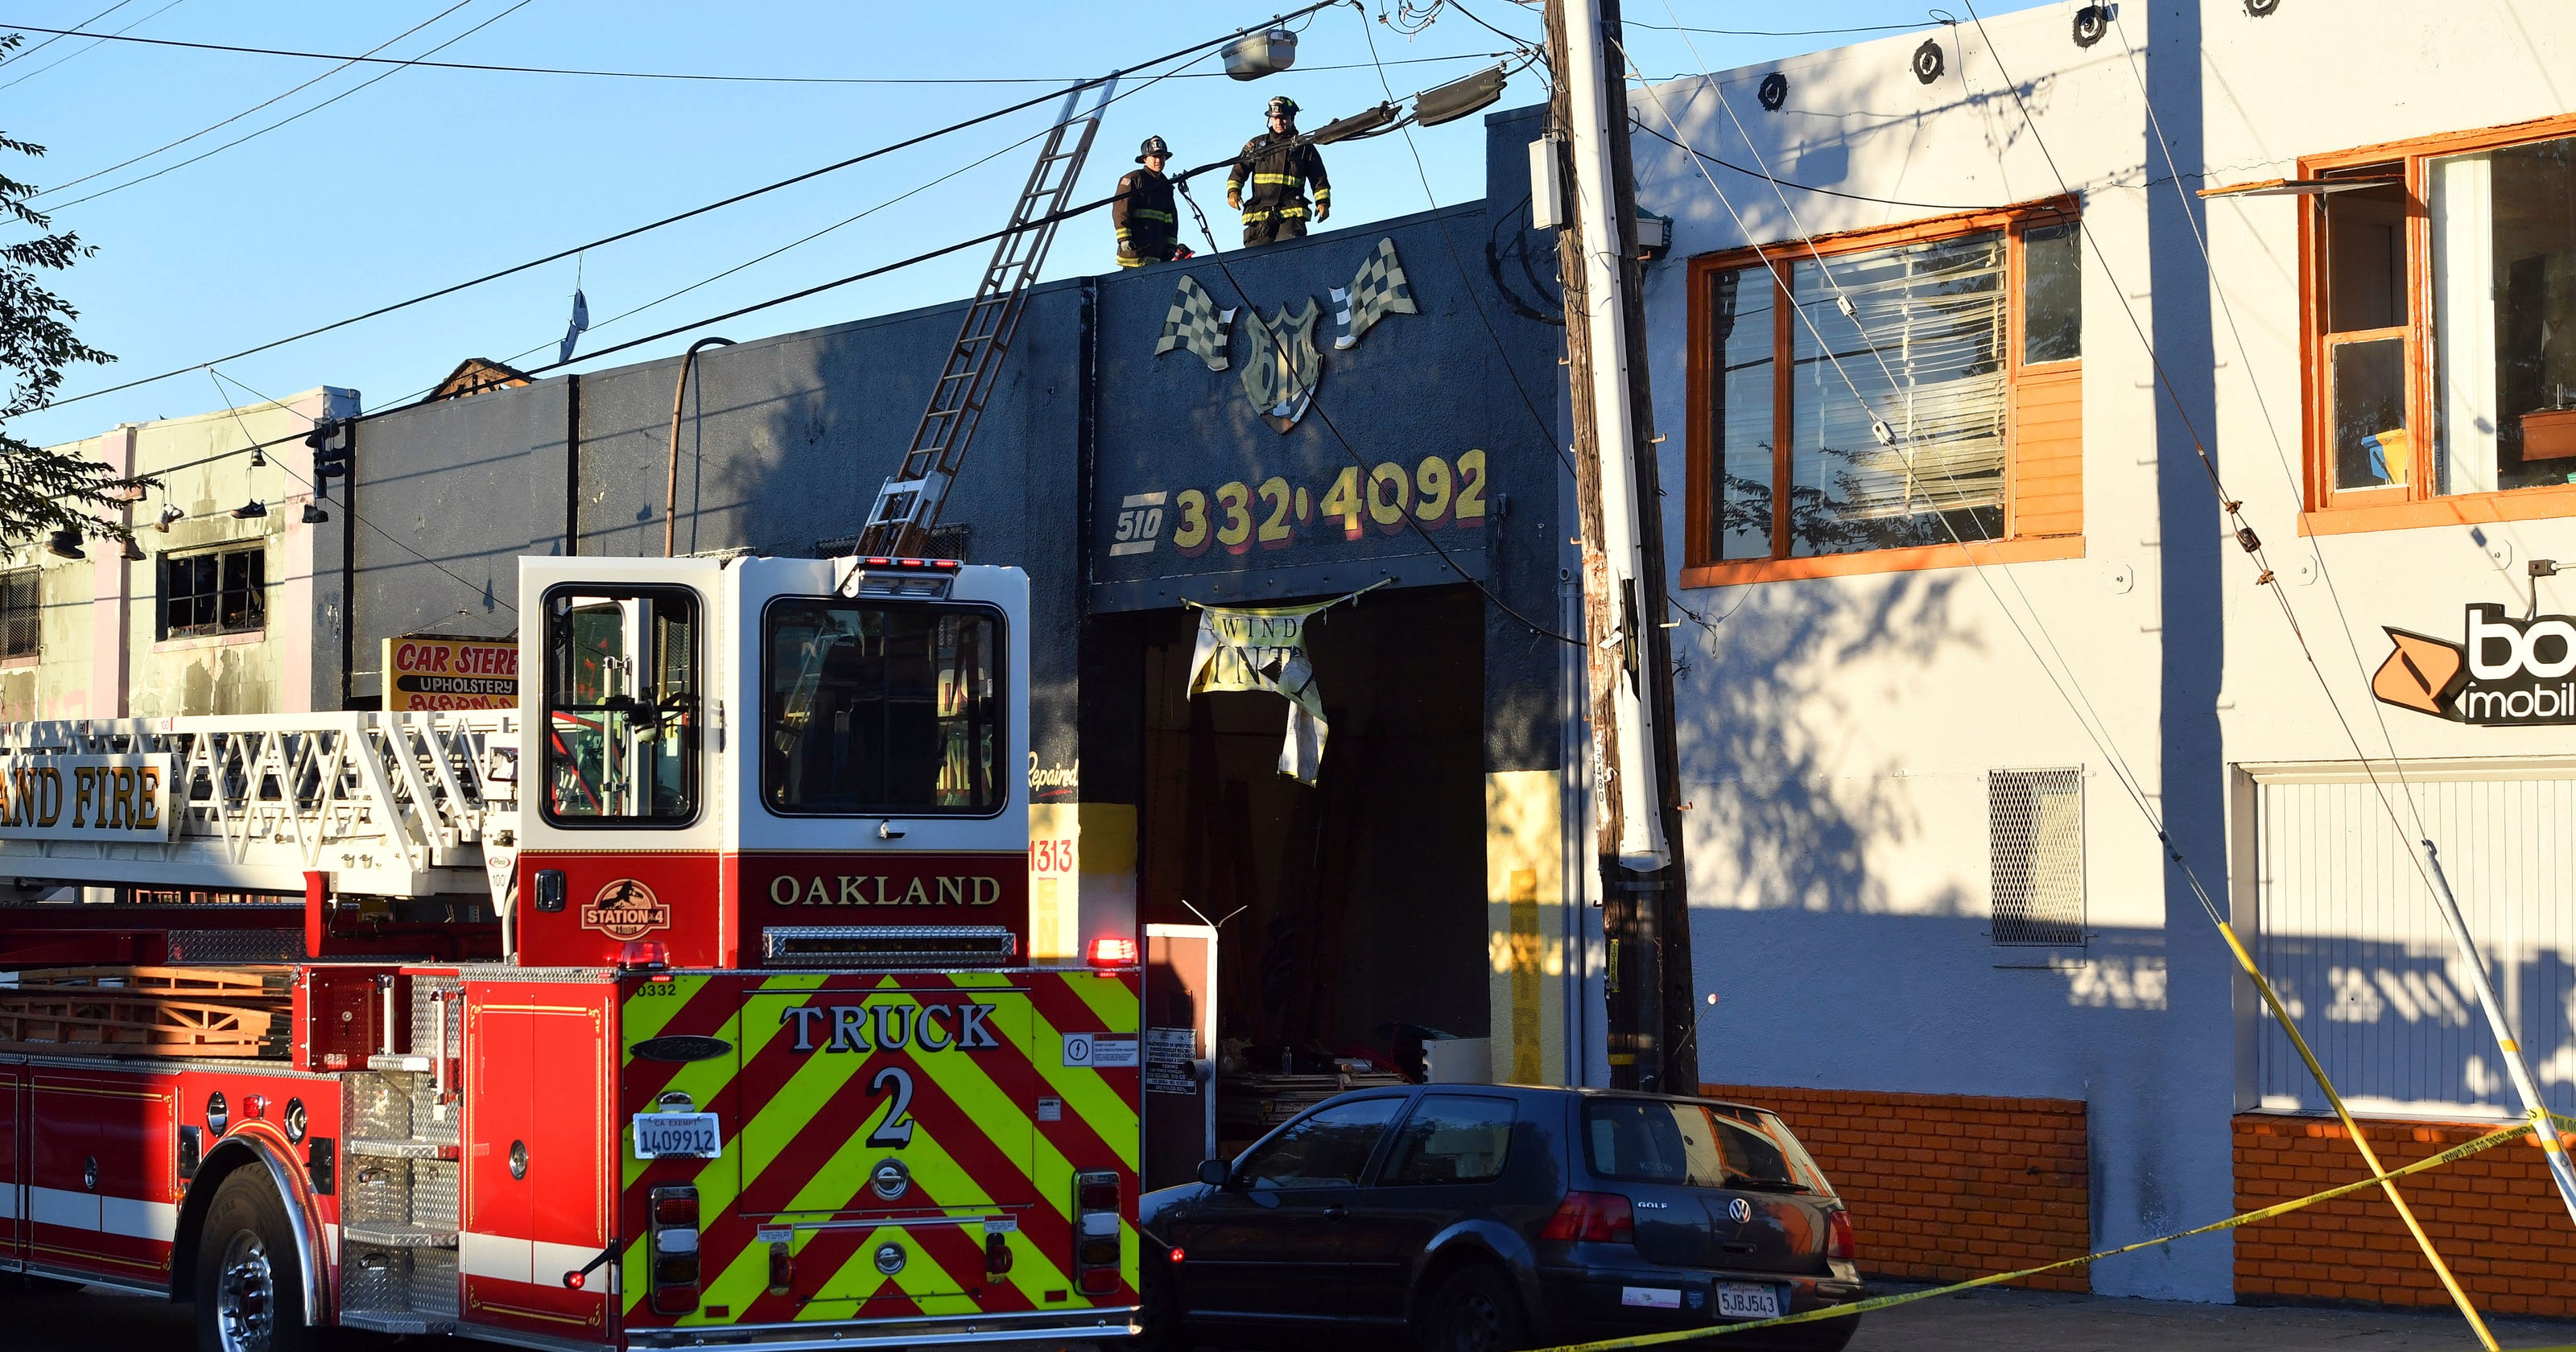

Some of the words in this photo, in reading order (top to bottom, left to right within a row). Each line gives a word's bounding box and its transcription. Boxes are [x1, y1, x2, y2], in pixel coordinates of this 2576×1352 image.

[1115, 507, 1162, 542] 510
[1222, 618, 1297, 638] WIND
[396, 643, 450, 674] CAR
[454, 645, 518, 676] STERE
[420, 676, 514, 695] UPHOLSTERY
[2469, 682, 2575, 719] mobil
[72, 766, 159, 831] FIRE
[770, 875, 1001, 906] OAKLAND
[587, 909, 648, 923] STATION
[654, 910, 663, 923] 4
[637, 983, 676, 997] 0332
[779, 1004, 999, 1053] TRUCK
[866, 1066, 914, 1149] 2
[641, 1130, 716, 1152] 1409912
[1721, 1293, 1775, 1313] 5JBJ543
